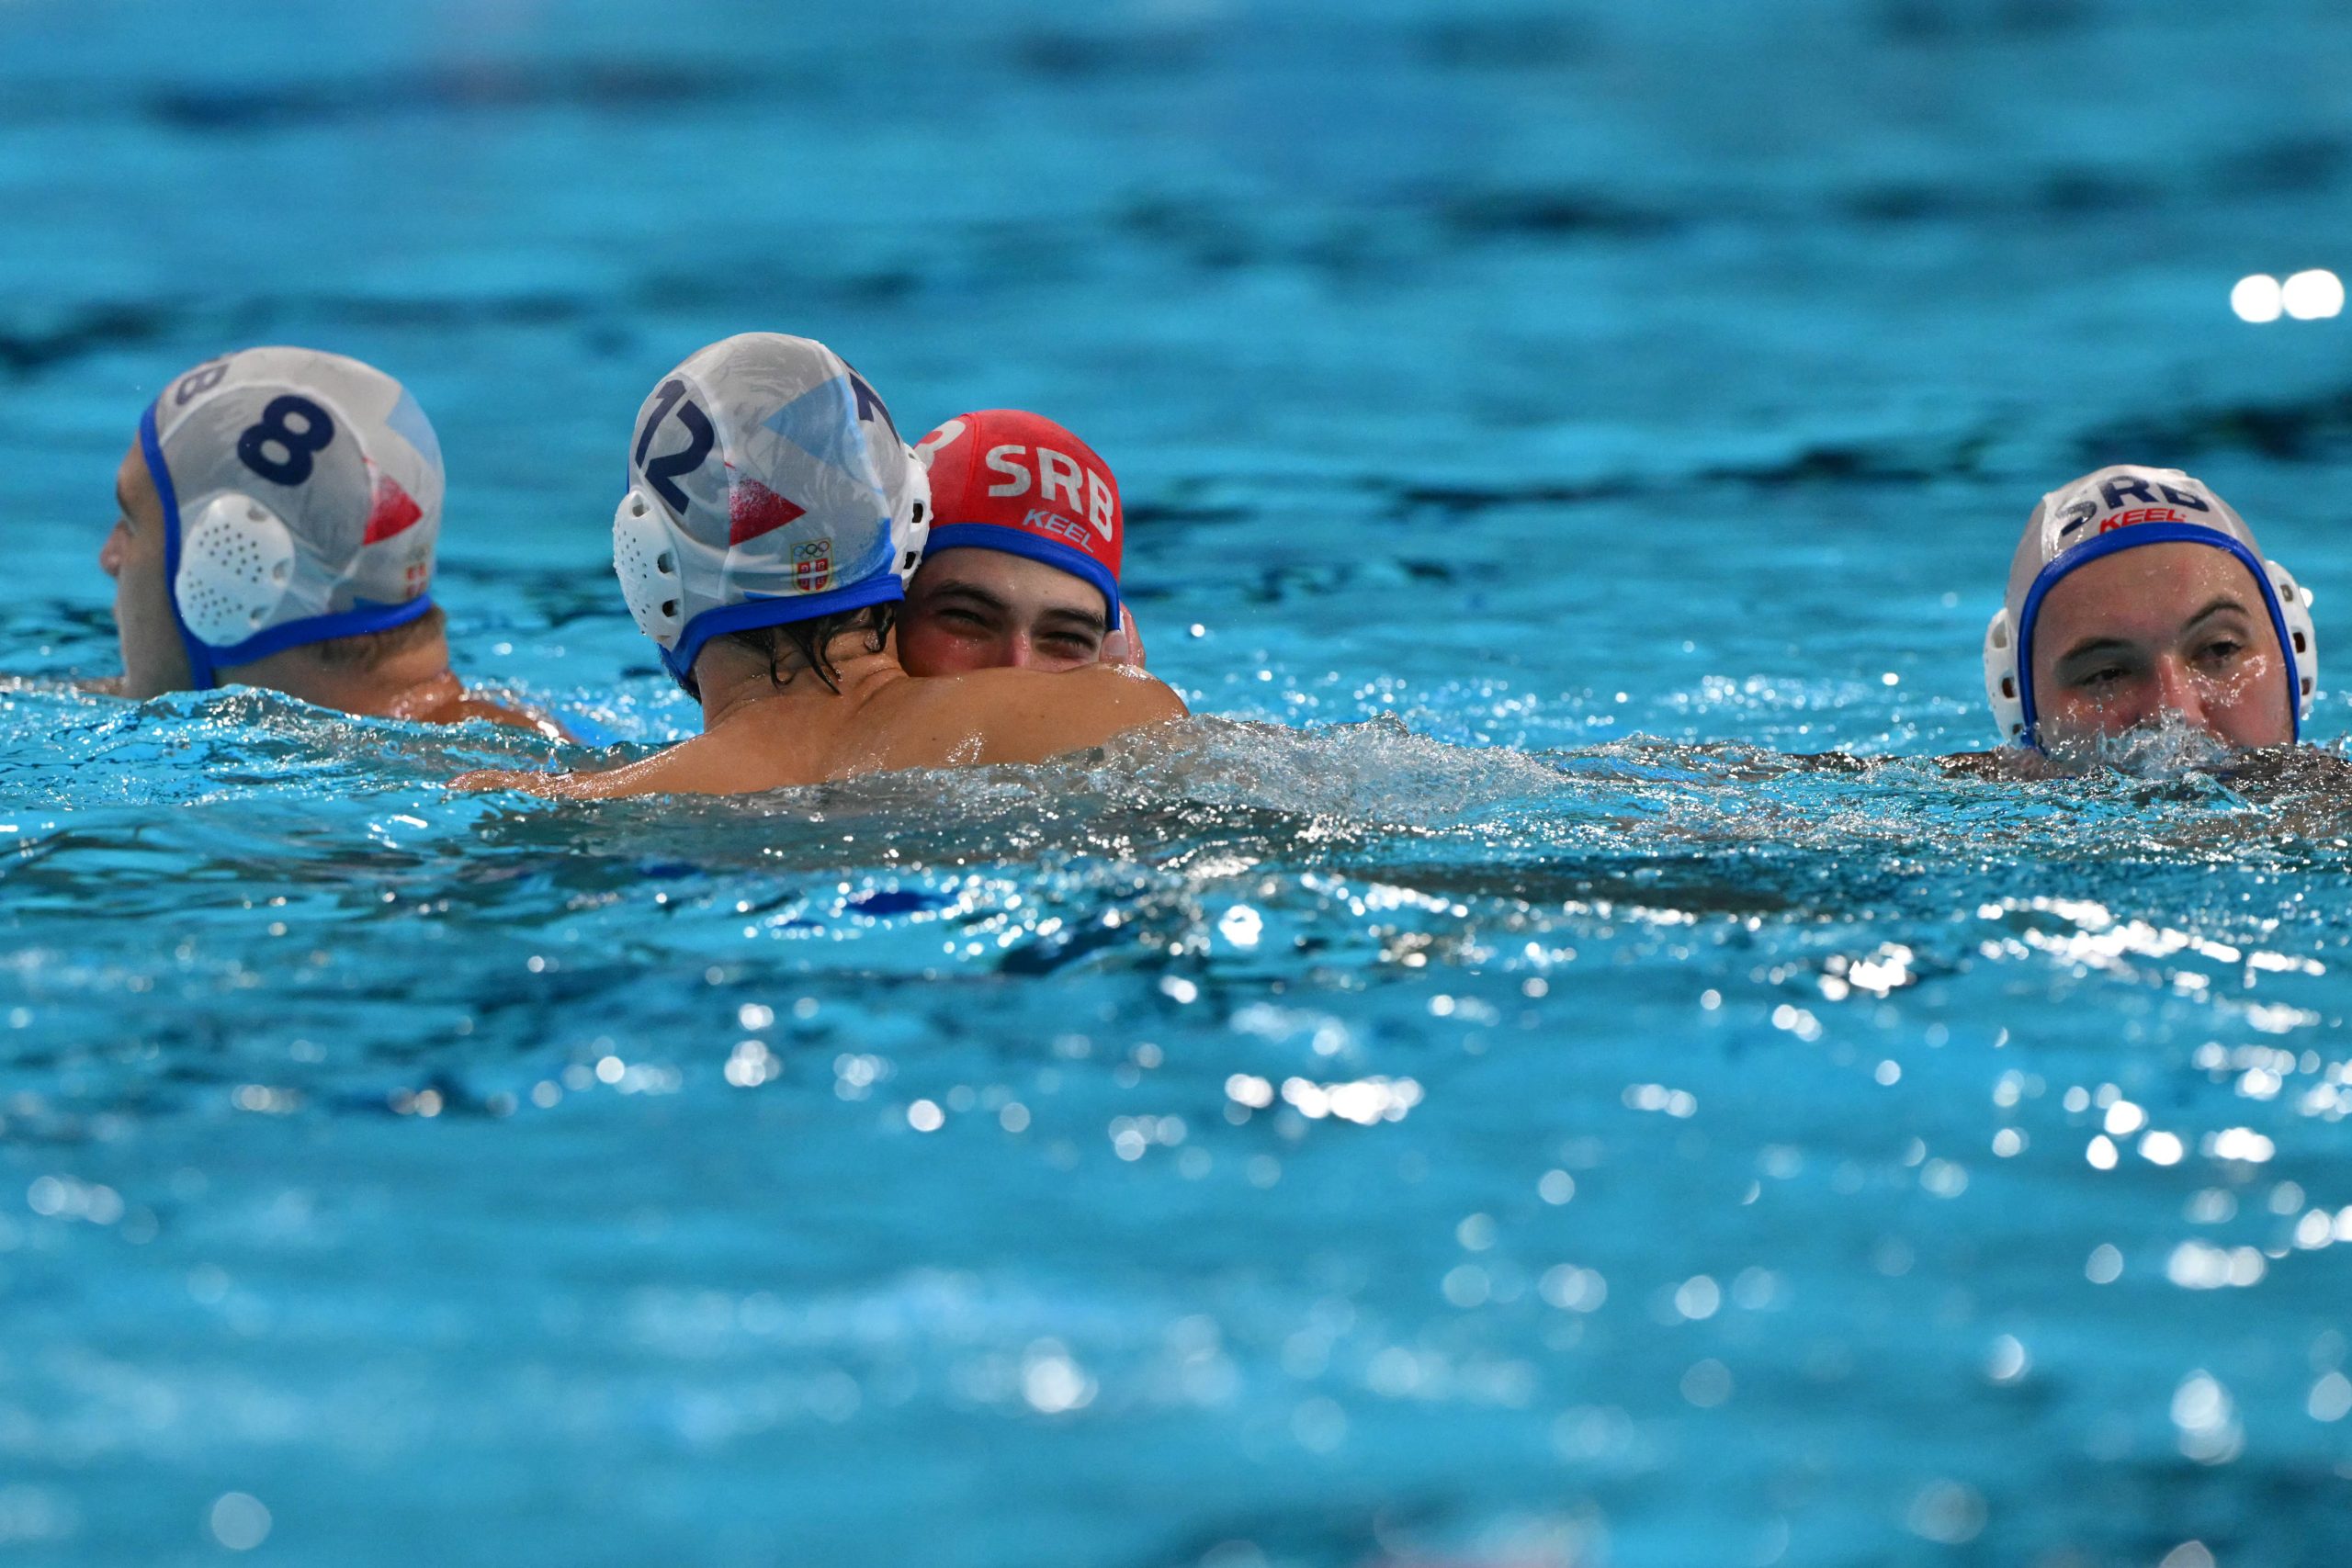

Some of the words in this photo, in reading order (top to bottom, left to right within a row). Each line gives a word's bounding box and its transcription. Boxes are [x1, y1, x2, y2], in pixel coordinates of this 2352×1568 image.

[237, 395, 334, 486] 8
[635, 379, 715, 516] 12
[985, 445, 1114, 542] SRB
[1023, 509, 1093, 553] KEEL
[2099, 508, 2185, 535] KEEL
